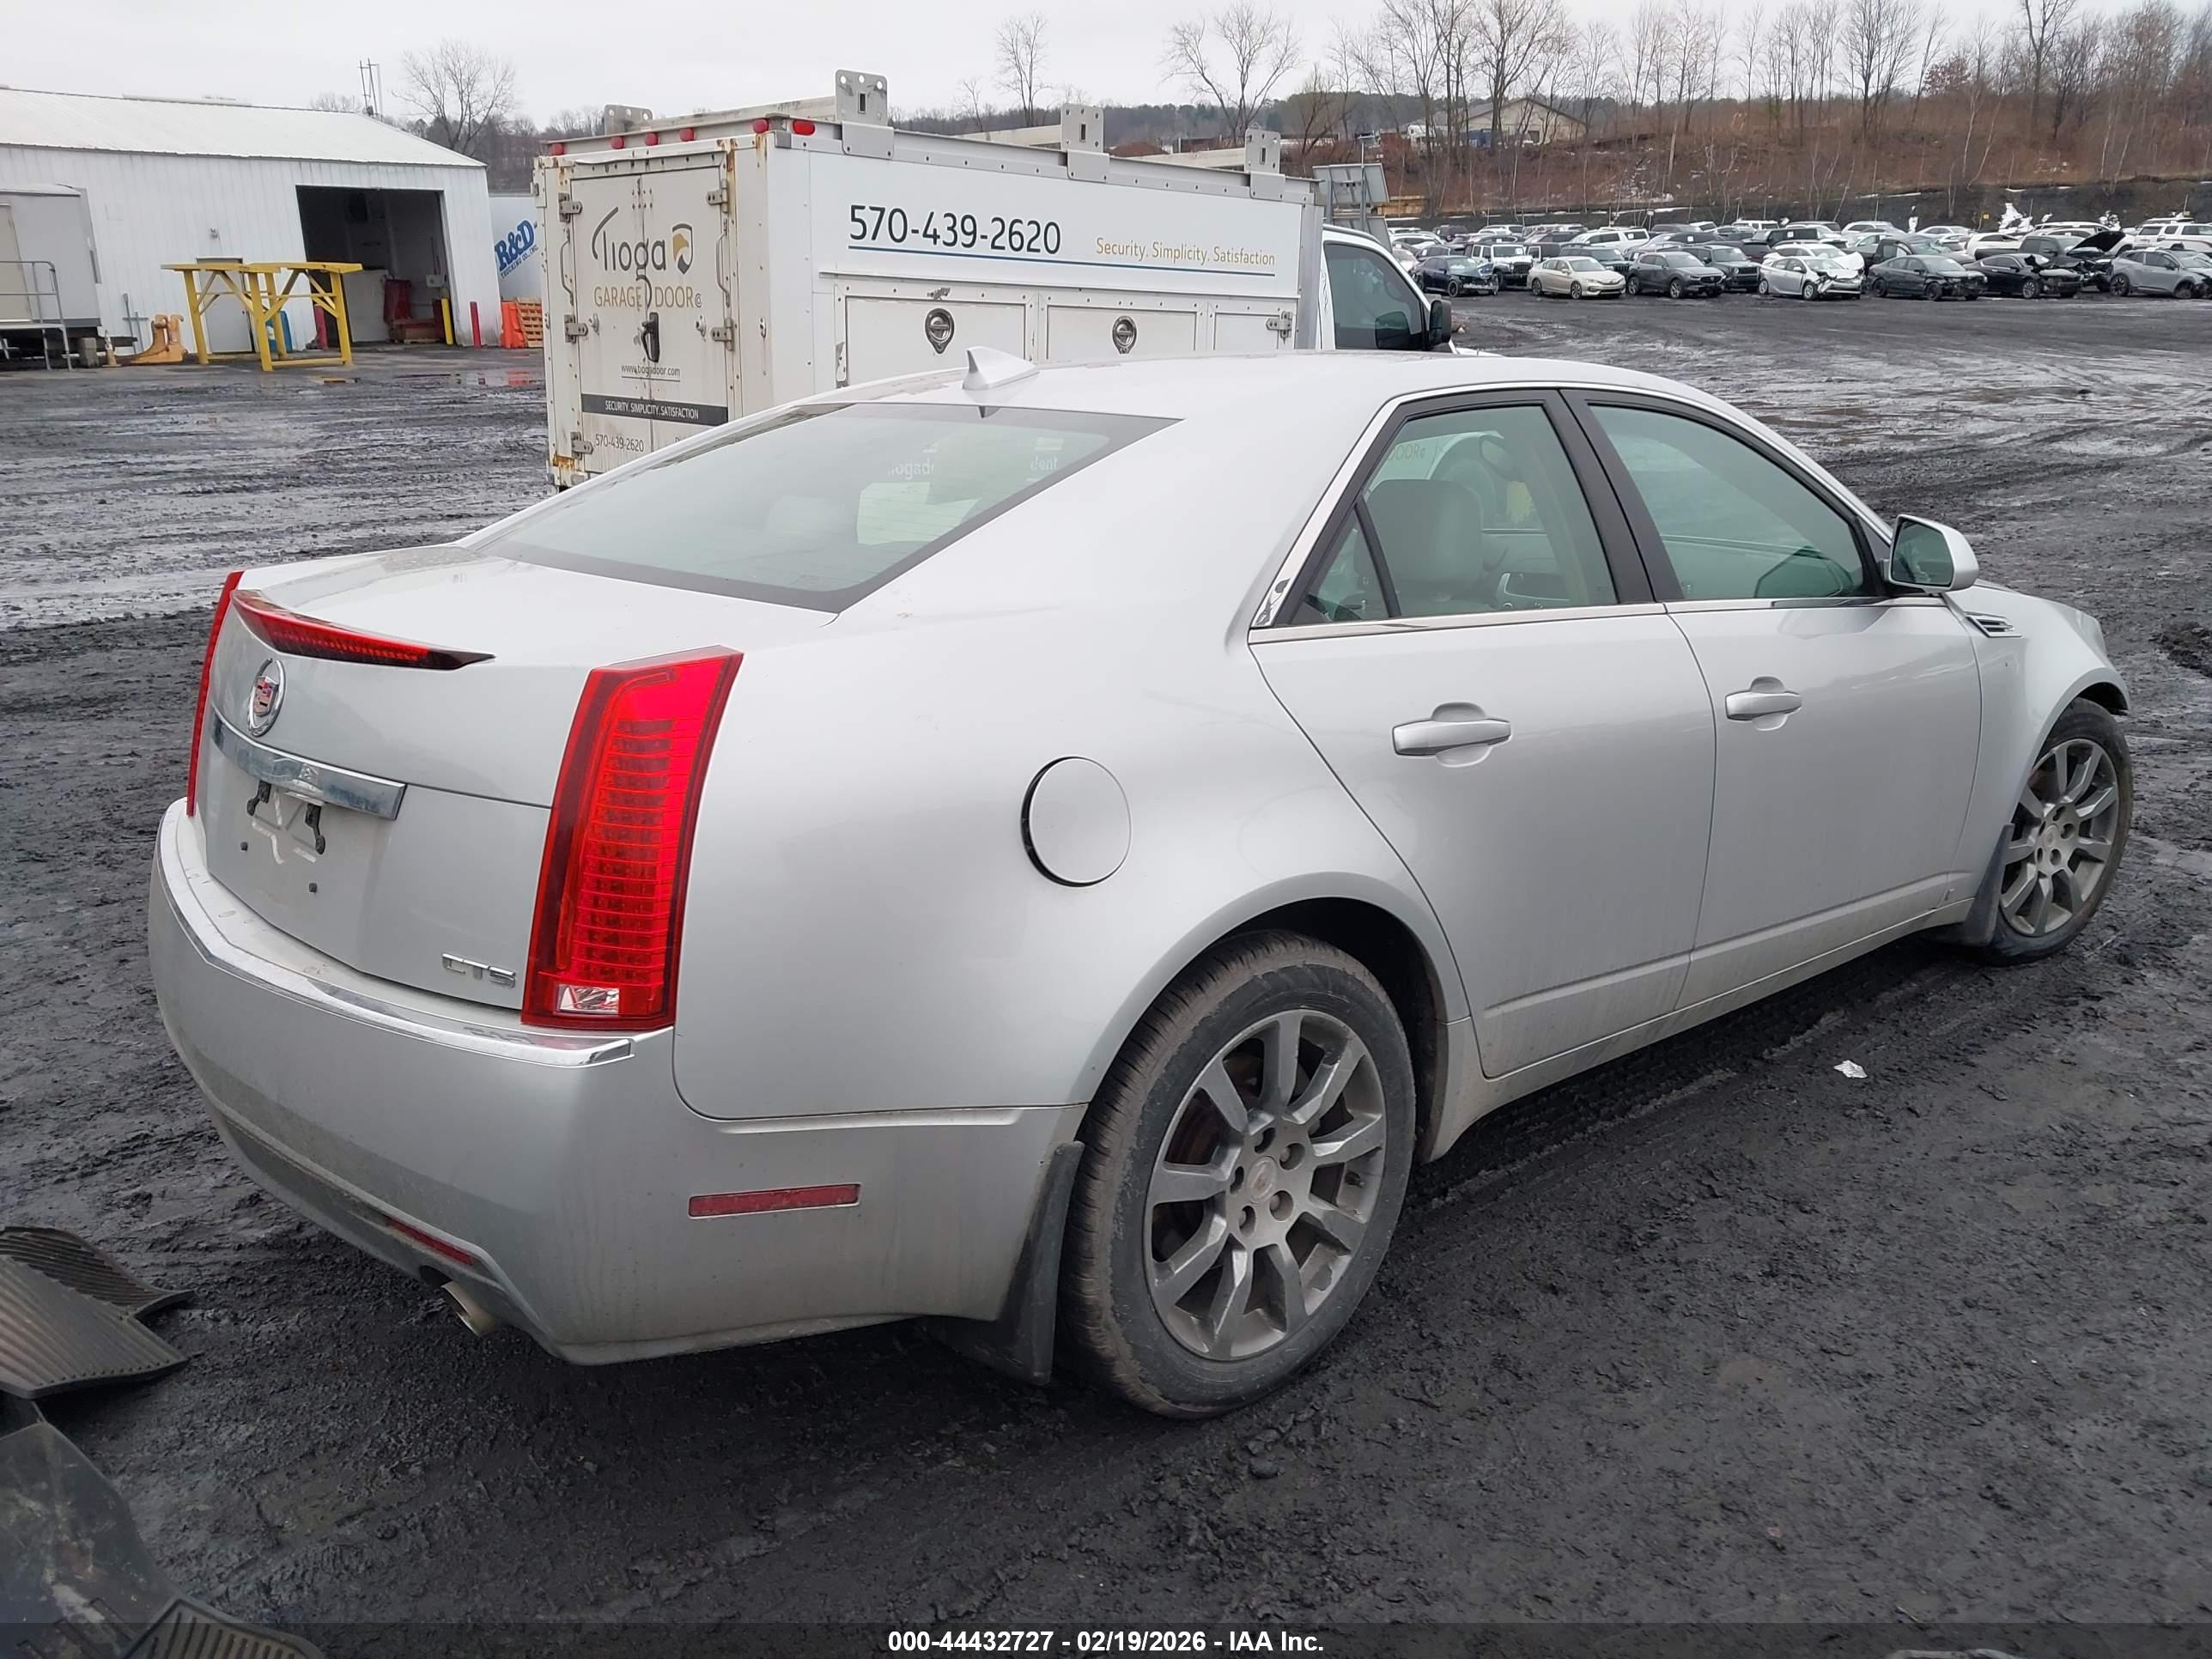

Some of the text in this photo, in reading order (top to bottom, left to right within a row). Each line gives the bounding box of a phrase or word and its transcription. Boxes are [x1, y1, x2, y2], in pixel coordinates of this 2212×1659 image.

[495, 220, 535, 271] R&D
[849, 204, 1061, 255] 570-439-2620
[592, 206, 666, 309] Tioga
[1096, 237, 1275, 266] Security. Simplicity. Satisfaction
[594, 285, 643, 308] GARAGE
[654, 285, 694, 308] DOOR
[605, 399, 630, 412] SECURITY.
[660, 405, 699, 420] SATISFACTION
[595, 433, 644, 453] 570-439-2620
[441, 952, 517, 988] CTS
